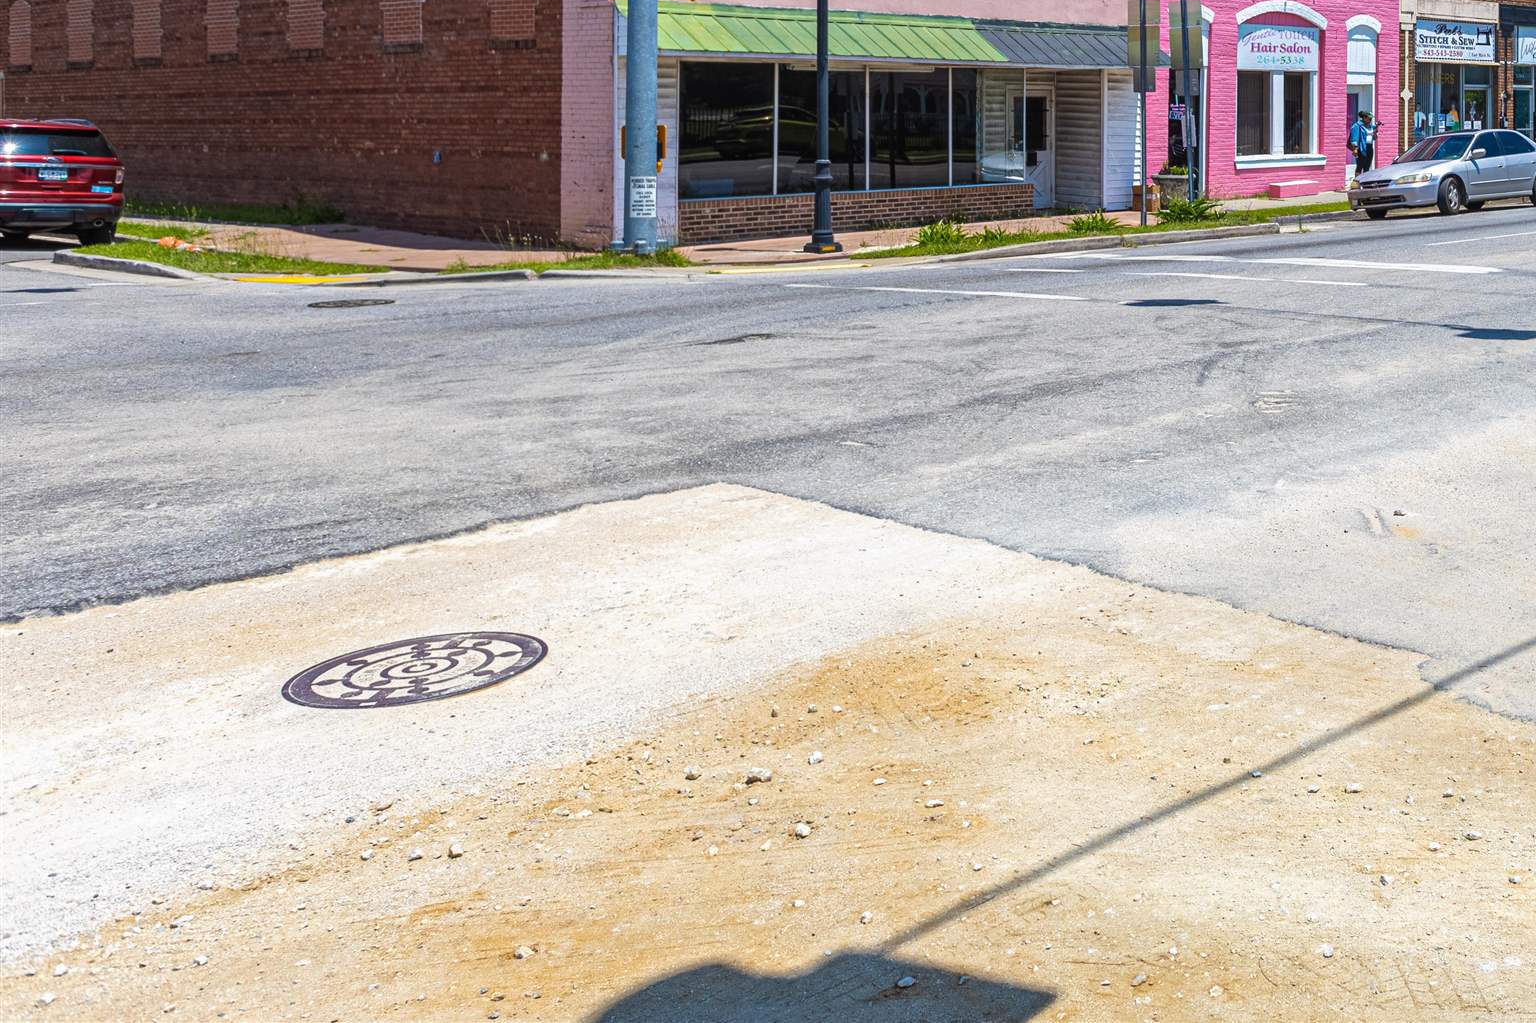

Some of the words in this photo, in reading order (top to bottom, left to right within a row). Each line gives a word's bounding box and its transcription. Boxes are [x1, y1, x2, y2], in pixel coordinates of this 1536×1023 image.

[1419, 34, 1449, 45] STITCH
[1451, 37, 1457, 45] &
[1458, 36, 1475, 46] SEW
[1250, 42, 1278, 53] Hair
[1280, 42, 1312, 54] Salon
